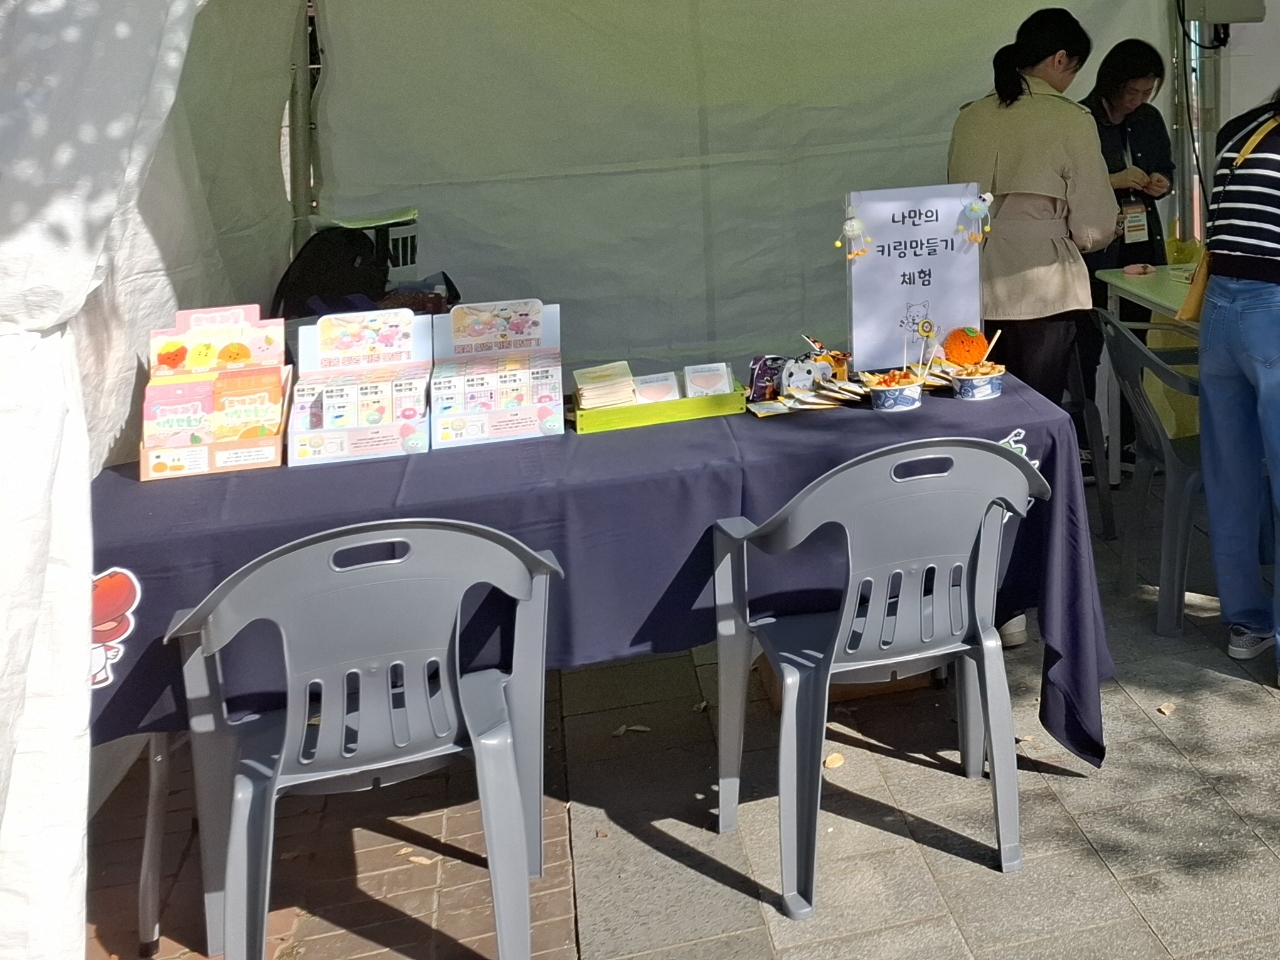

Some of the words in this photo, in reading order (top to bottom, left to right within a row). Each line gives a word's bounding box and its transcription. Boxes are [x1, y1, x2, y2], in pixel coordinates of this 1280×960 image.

[891, 209, 939, 226] 나만의
[876, 237, 955, 258] 키링만들기
[900, 268, 932, 286] 체험
